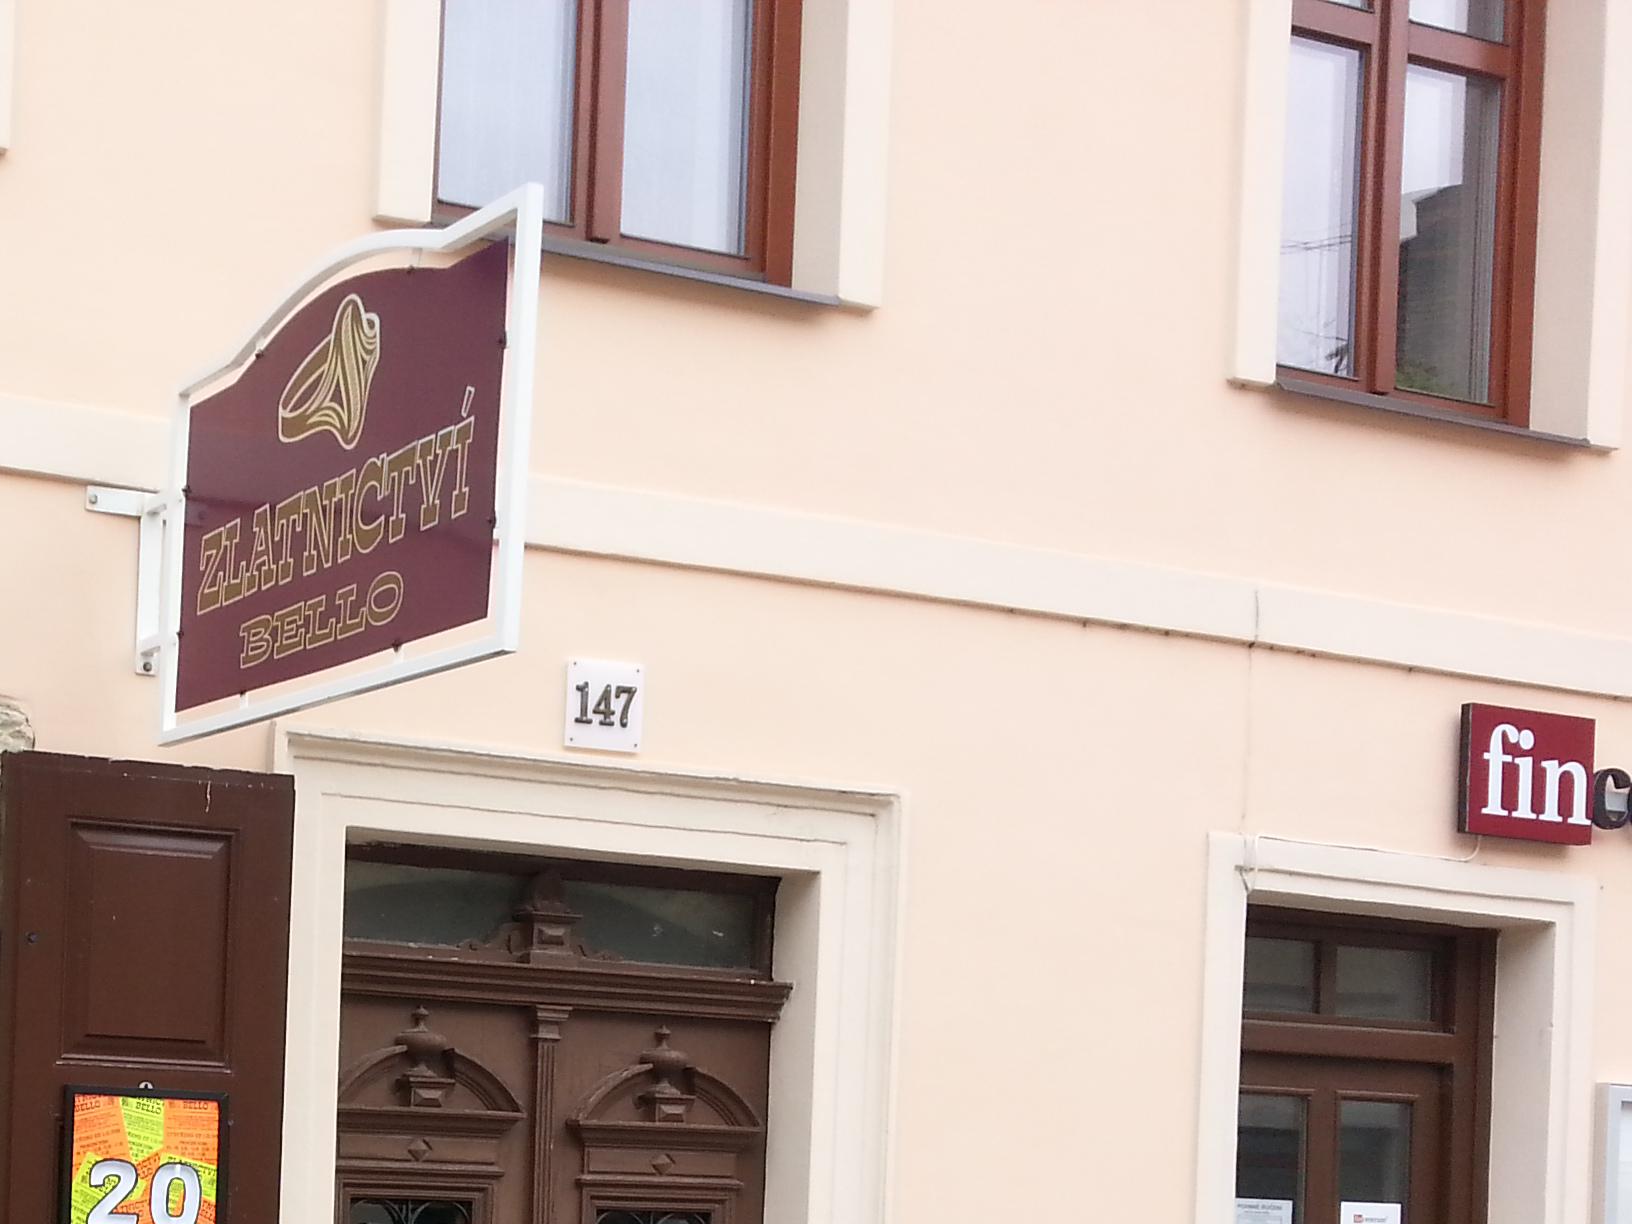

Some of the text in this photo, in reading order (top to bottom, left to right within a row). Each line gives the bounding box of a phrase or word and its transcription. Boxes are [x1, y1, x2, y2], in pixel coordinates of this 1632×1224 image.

[196, 386, 475, 616] ZLATNICTVÍ
[239, 571, 404, 669] BELLO
[574, 681, 638, 728] 147
[1481, 723, 1632, 830] finc
